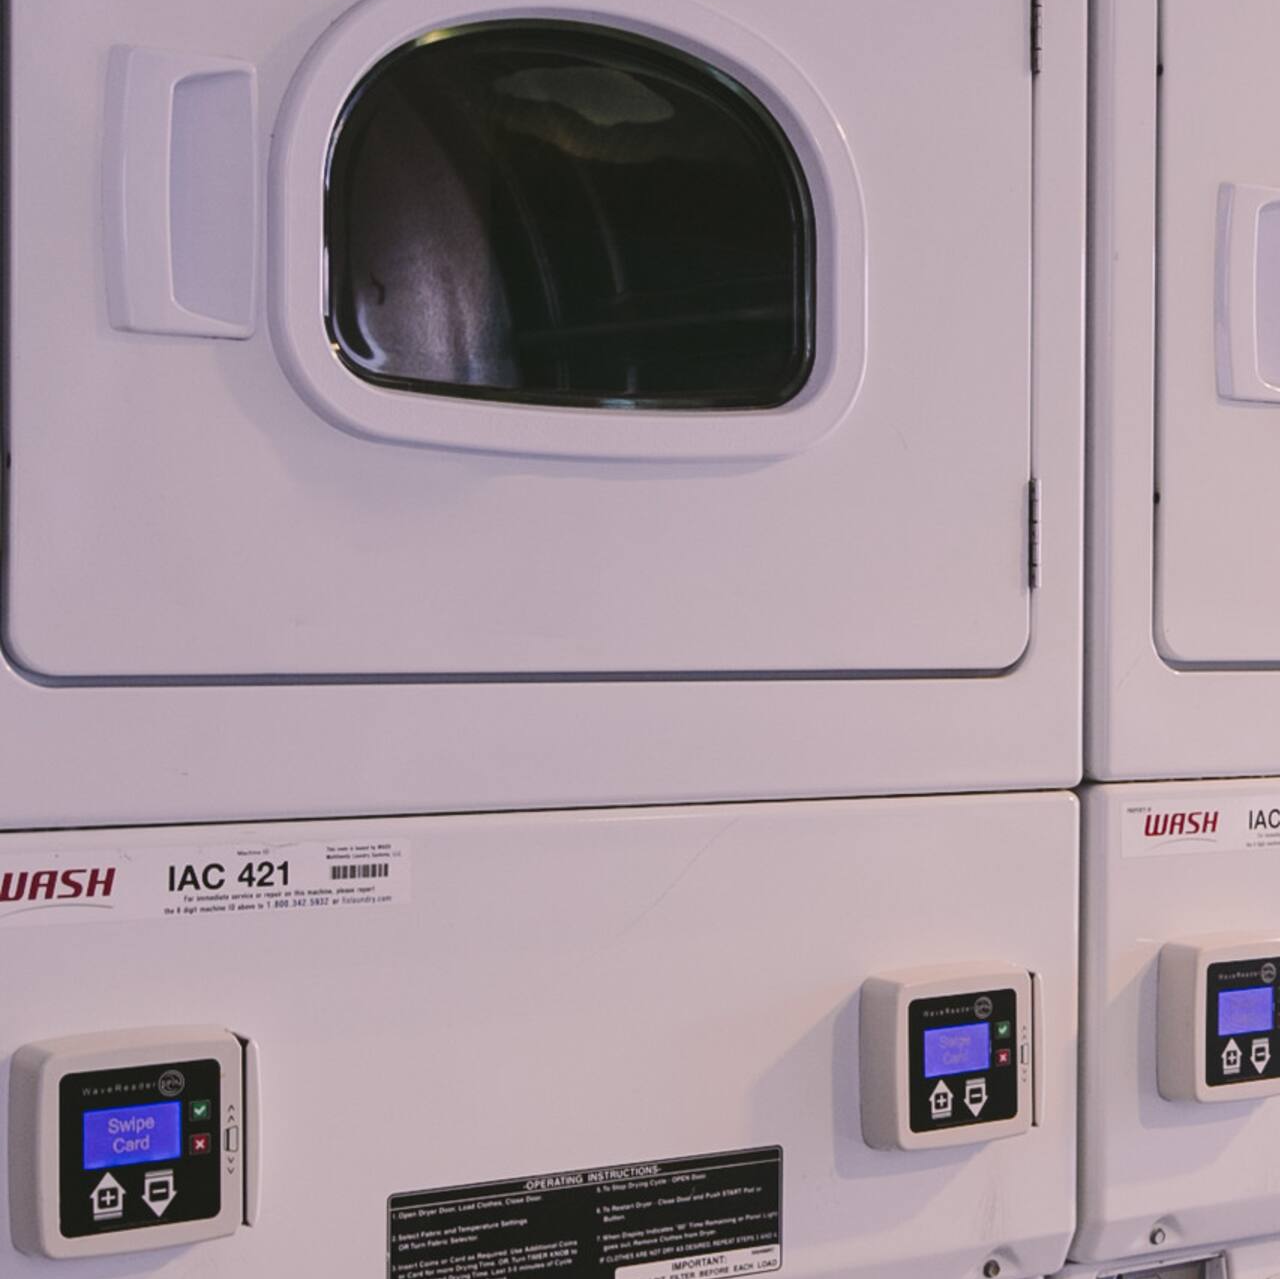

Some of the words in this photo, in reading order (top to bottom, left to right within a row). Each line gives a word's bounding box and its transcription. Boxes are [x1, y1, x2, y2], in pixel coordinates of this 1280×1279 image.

[1144, 811, 1219, 837] WASH
[1248, 808, 1280, 830] IAC
[169, 863, 225, 891] IAC
[238, 861, 289, 887] 421
[108, 1114, 155, 1135] Swipe
[112, 1136, 150, 1154] Card
[526, 1175, 583, 1190] OPERATING
[588, 1165, 658, 1182] INSTRUCTIONS
[699, 1266, 729, 1277] BEFORE
[733, 1262, 754, 1273] EACH
[757, 1258, 778, 1269] LOAD
